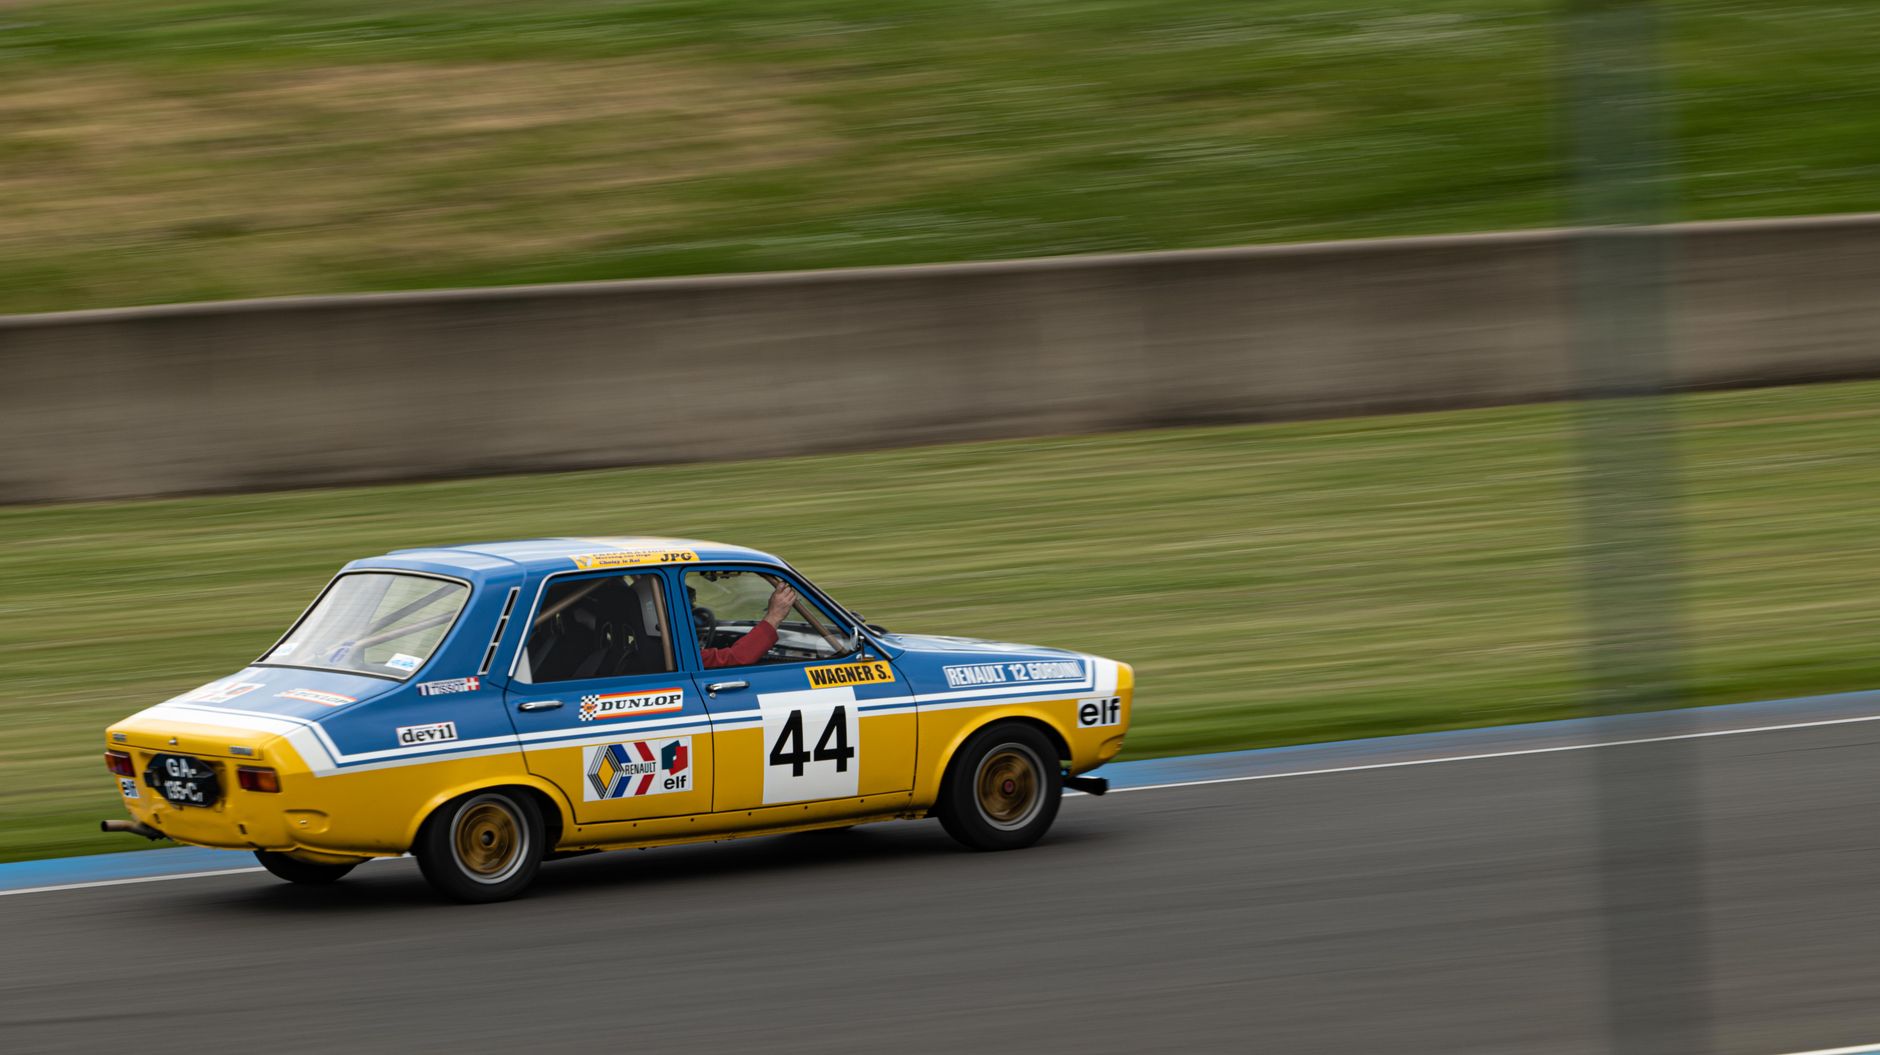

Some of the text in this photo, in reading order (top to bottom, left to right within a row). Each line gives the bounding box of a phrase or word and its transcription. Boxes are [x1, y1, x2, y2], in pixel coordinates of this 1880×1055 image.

[661, 552, 692, 562] JPG
[809, 664, 891, 686] WAGNER S.
[946, 665, 1006, 686] RENAULT
[1008, 663, 1029, 681] 12
[600, 694, 681, 711] DUNLOP
[1079, 698, 1120, 726] elf
[402, 724, 454, 743] devil
[769, 705, 854, 777] 44
[624, 762, 656, 775] RENAULT
[663, 775, 687, 790] elf
